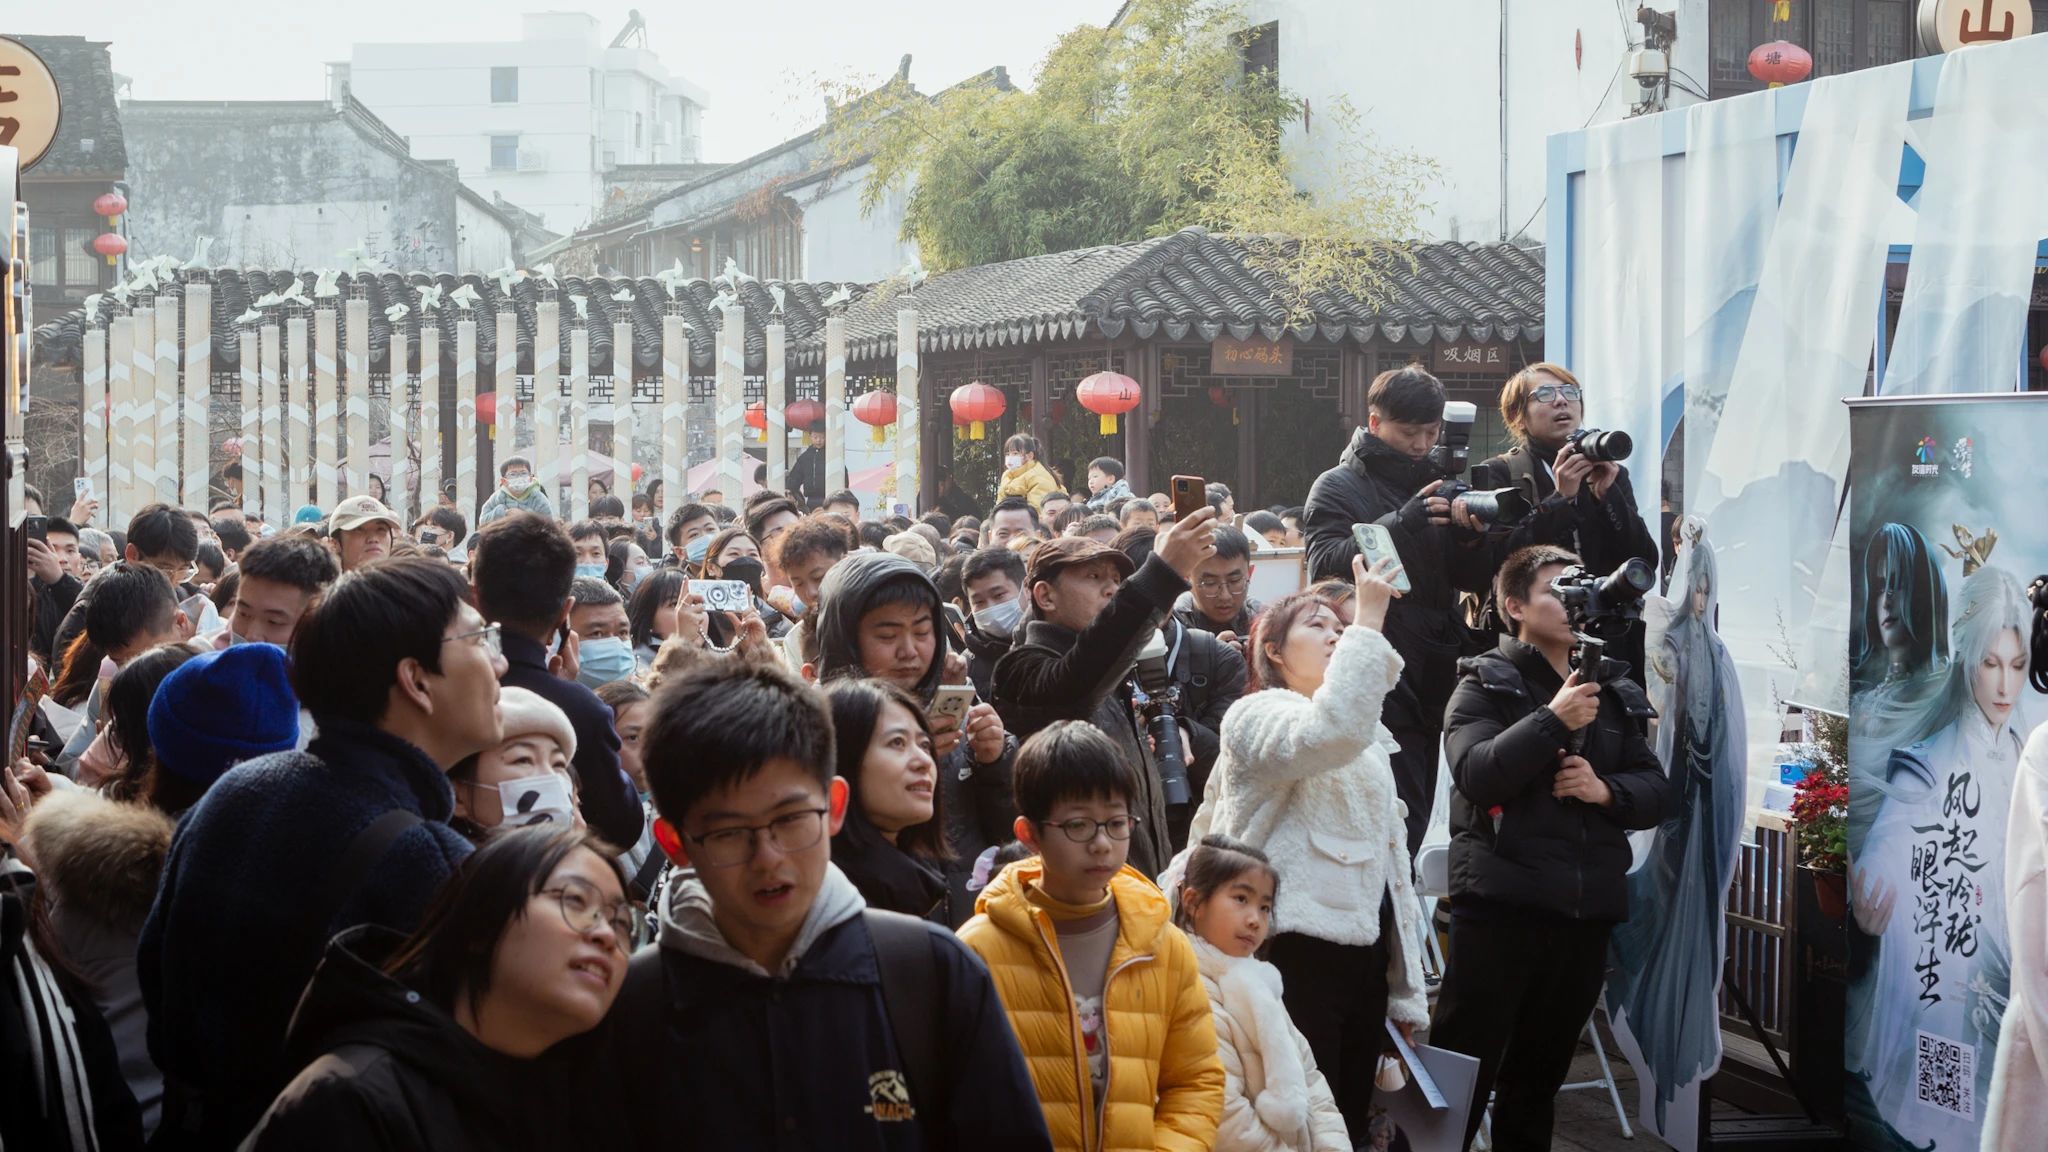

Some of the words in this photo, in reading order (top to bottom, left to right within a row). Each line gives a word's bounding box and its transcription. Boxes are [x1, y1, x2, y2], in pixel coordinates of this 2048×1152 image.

[1959, 0, 2015, 44] 山
[1443, 345, 1500, 363] 吸烟区
[1119, 387, 1132, 401] 山
[1911, 823, 1947, 1011] 一眼浮生
